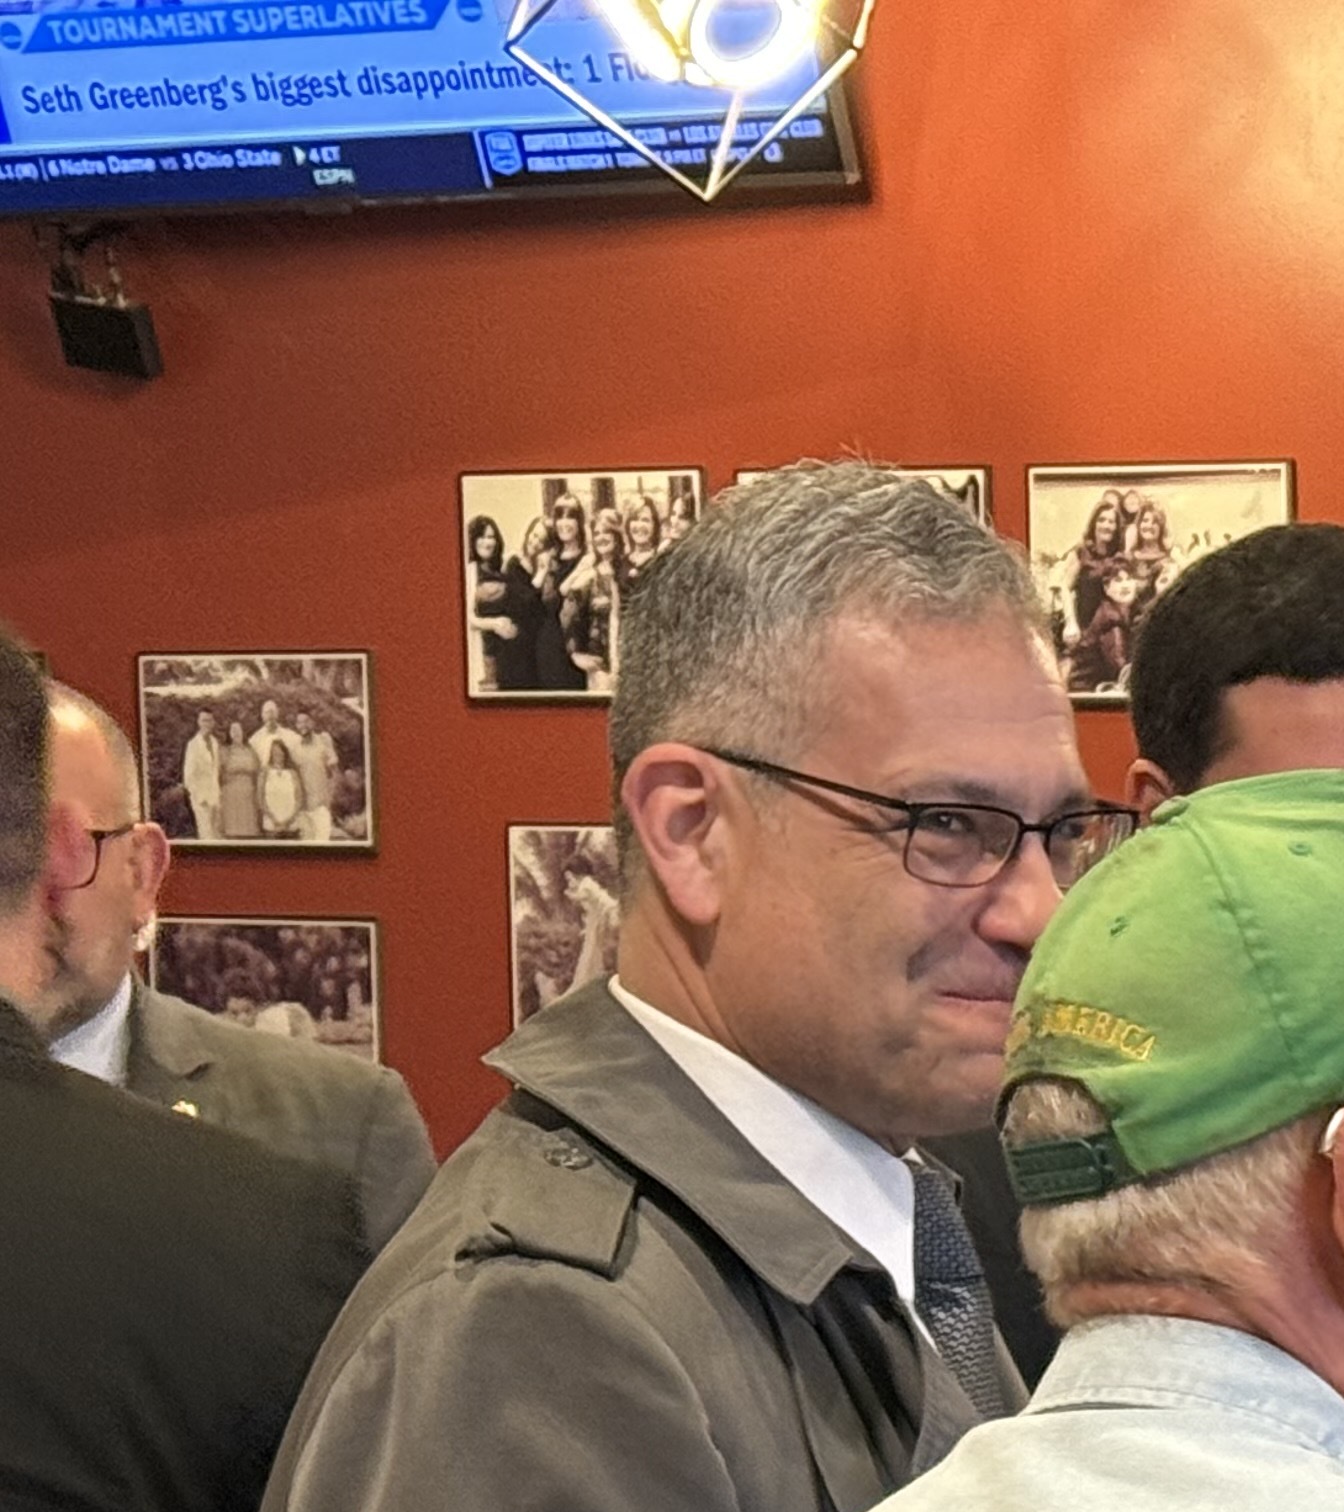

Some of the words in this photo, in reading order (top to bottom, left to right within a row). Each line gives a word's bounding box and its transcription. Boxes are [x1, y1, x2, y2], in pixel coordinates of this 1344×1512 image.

[48, 11, 227, 44] TOURNAMENT
[234, 1, 428, 34] SUPERLATIVES
[21, 84, 83, 114] Seth
[89, 75, 247, 112] Greenberg's
[251, 69, 352, 107] biggest
[583, 53, 602, 83] 1
